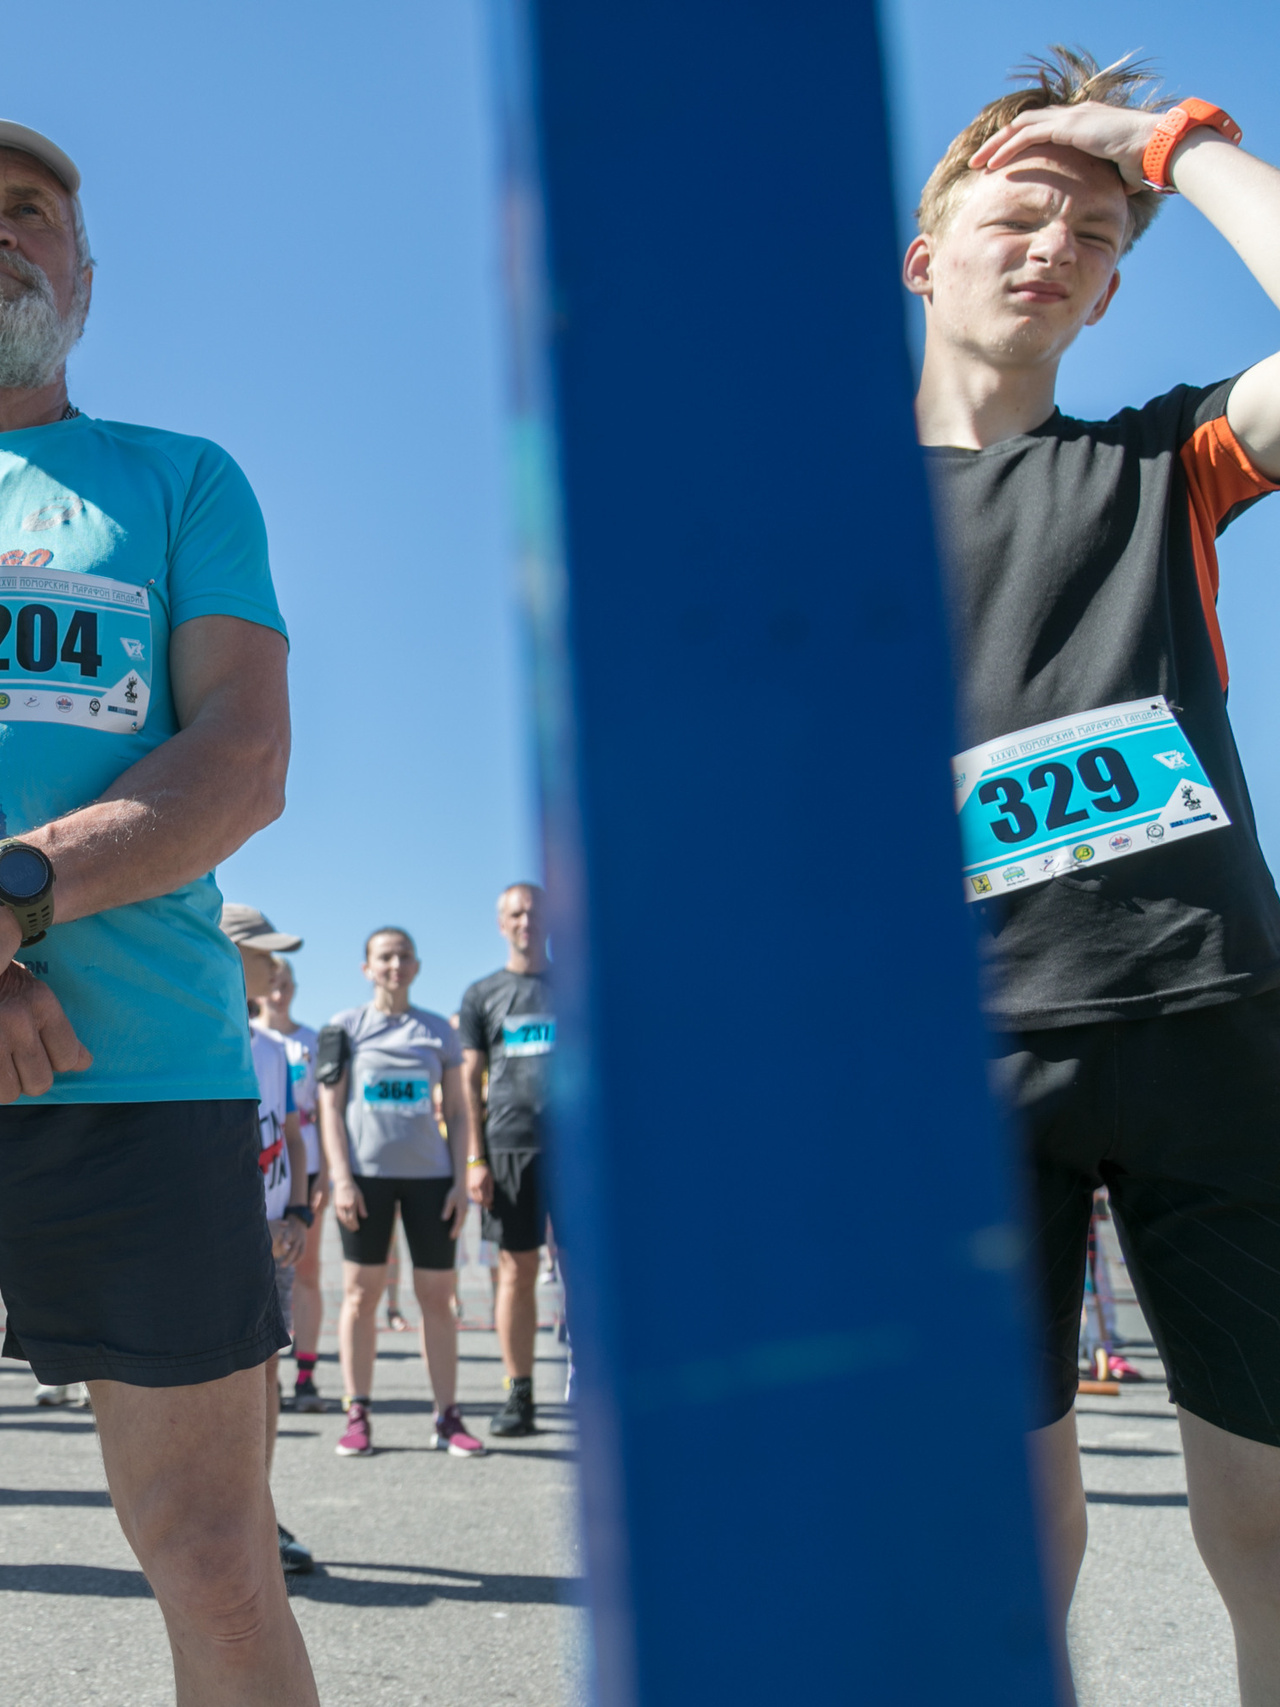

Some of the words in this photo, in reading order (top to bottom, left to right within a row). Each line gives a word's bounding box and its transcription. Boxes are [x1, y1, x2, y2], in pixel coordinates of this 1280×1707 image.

[19, 578, 69, 592] ПОМОРСКИЙ
[72, 583, 110, 599] МАРАФОН
[112, 590, 145, 607] ГАНДВИК
[990, 747, 1018, 764] XXXVII
[1020, 729, 1075, 754] ПОМОРСКИЙ
[1077, 717, 1123, 736] МАРАФОН
[1124, 709, 1166, 724] ГАНДВИК
[978, 747, 1140, 844] 329
[378, 1080, 415, 1101] 364
